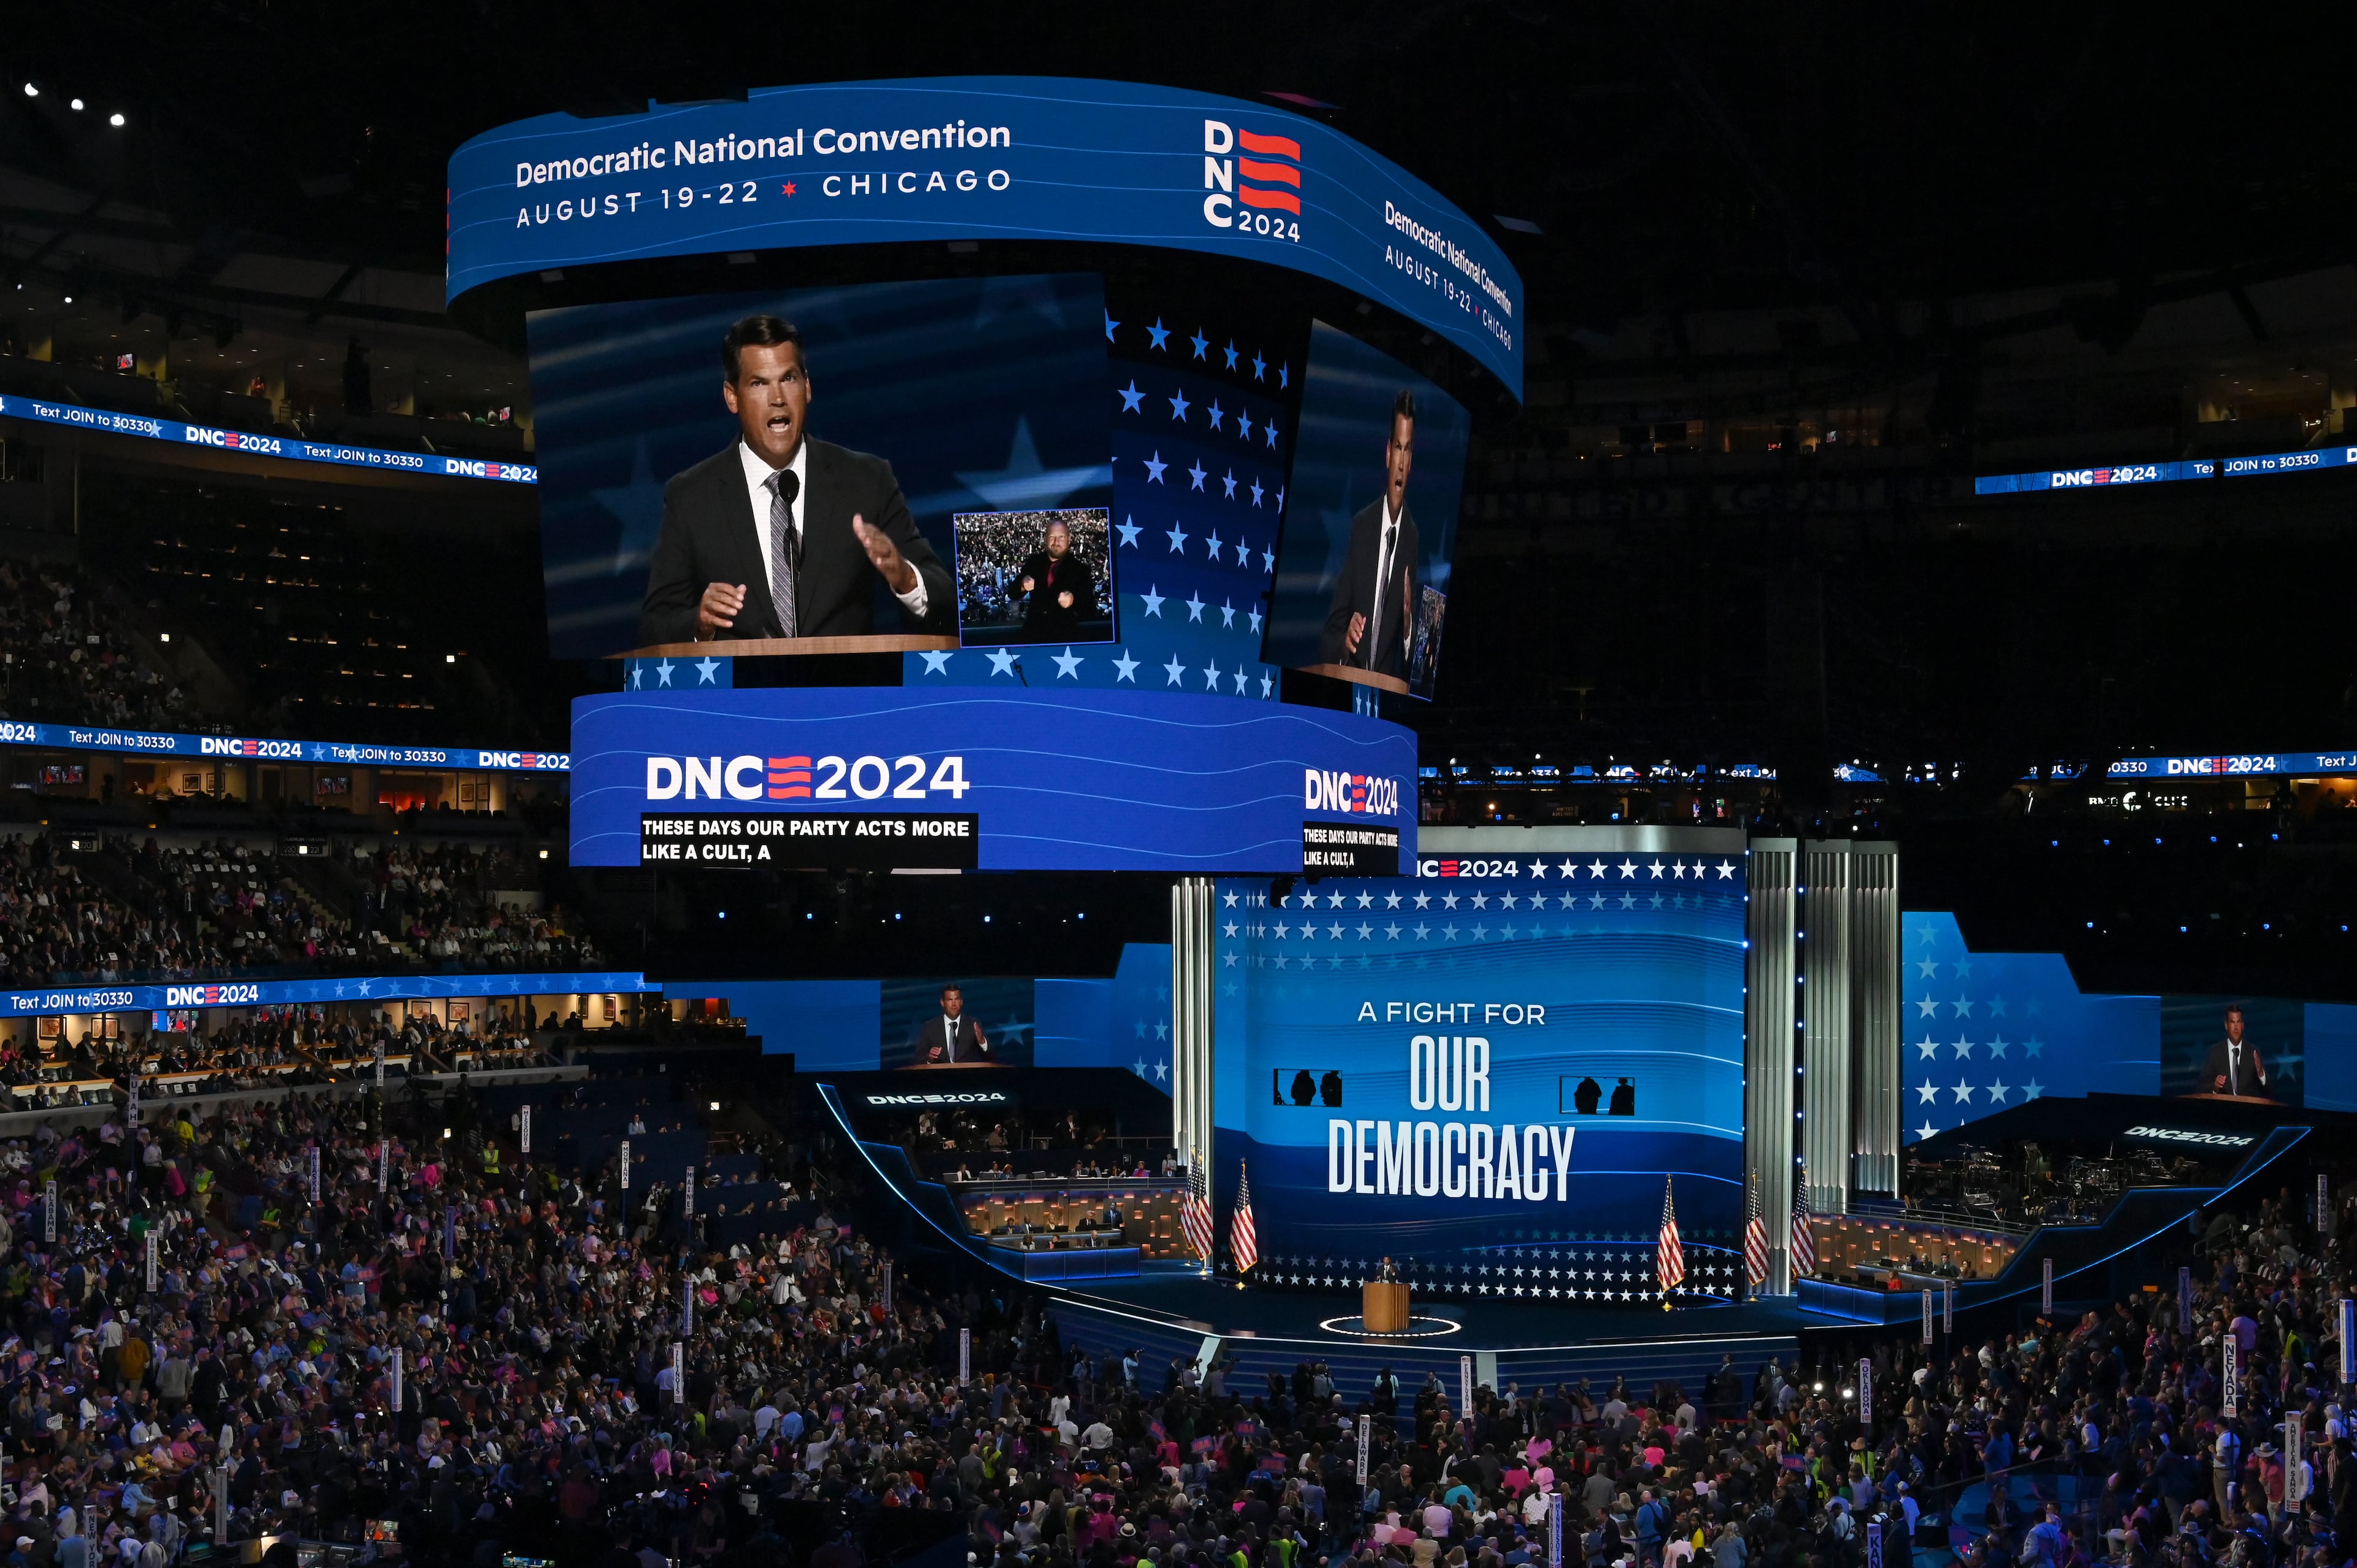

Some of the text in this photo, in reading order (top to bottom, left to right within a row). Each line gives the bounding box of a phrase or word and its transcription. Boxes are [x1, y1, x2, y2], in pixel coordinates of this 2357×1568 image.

[517, 120, 1010, 188] Democratic National Convention
[516, 169, 1010, 228] AUGUST 19-22 CHICAGO
[1239, 211, 1300, 242] 2024
[1385, 201, 1511, 318] Democratic National Convention
[1386, 245, 1511, 350] AUGUST 19-22 CHICAGO
[33, 404, 60, 419] Text
[63, 409, 94, 423] JOIN
[98, 415, 110, 426] to
[113, 417, 152, 432] 30330
[304, 445, 331, 460] Text
[334, 449, 365, 462] JOIN
[368, 452, 381, 463] to
[384, 454, 423, 468] 30330
[2225, 460, 2258, 472] JOIN
[2262, 459, 2275, 469] to
[2280, 454, 2319, 468] 30330
[0, 723, 36, 741] 024
[69, 730, 92, 743] Text
[95, 733, 121, 745] JOIN
[125, 735, 134, 746] to
[137, 737, 175, 749] 30330
[331, 747, 356, 758] Text
[358, 748, 387, 760] JOIN
[390, 750, 401, 761] to
[404, 751, 446, 762] 30330
[536, 754, 570, 769] 202
[2316, 755, 2346, 767] Text
[643, 820, 969, 836] THESE DAYS OUR PARTY ACTS MORE
[1304, 828, 1398, 847] THESE DAYS OUR PARTY ACTS MORE
[643, 844, 771, 863] LIKE A CULT, A
[1304, 851, 1354, 868] LIKE A CULT, A
[11, 996, 39, 1010] Text
[42, 994, 74, 1008] JOIN
[77, 995, 90, 1006] to
[93, 992, 133, 1006] 30330
[1358, 1002, 1545, 1025] A FIGHT FOR
[1410, 1035, 1490, 1112] OUR
[1328, 1119, 1575, 1202] DEMOCRACY
[2225, 1345, 2234, 1407] NEVADA
[48, 1415, 62, 1425] OHIO
[88, 1515, 96, 1540] NEW
[1871, 1536, 1879, 1568] KAN
